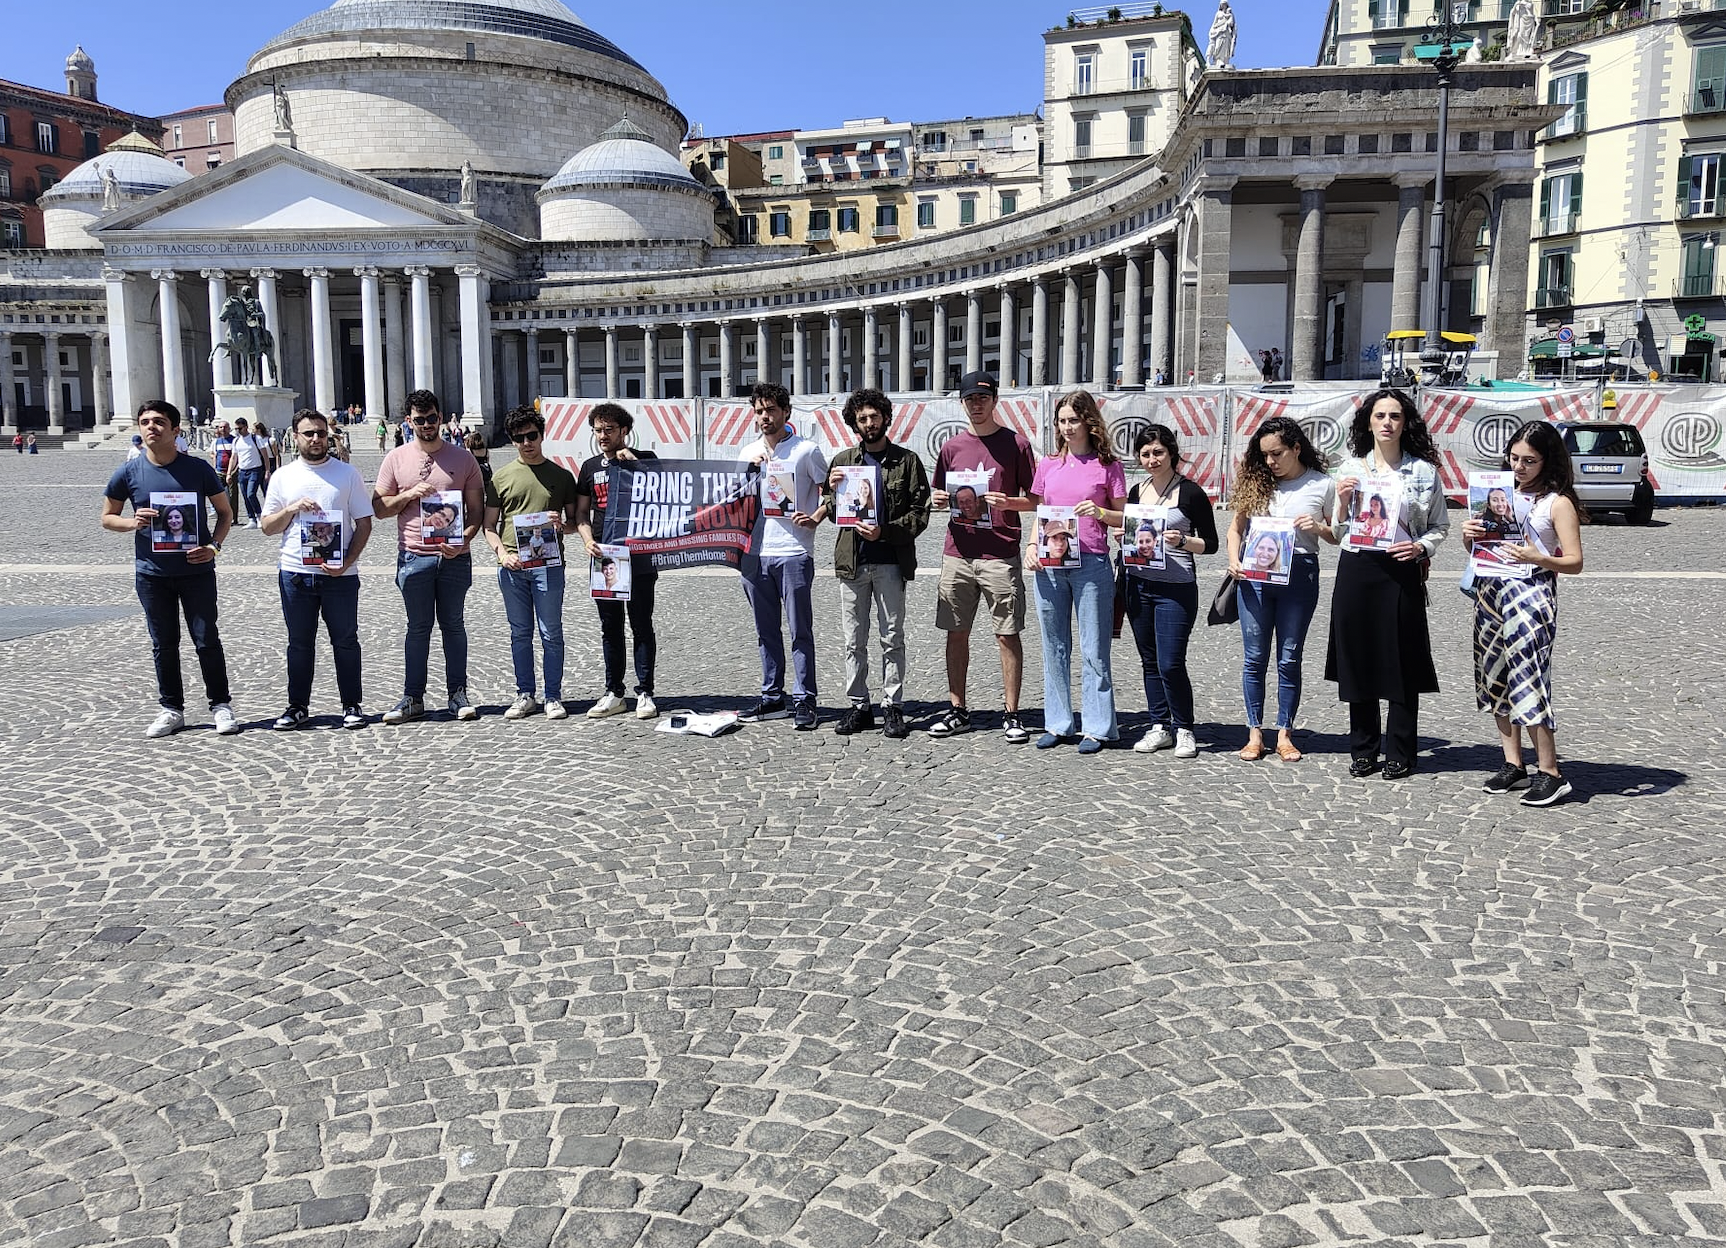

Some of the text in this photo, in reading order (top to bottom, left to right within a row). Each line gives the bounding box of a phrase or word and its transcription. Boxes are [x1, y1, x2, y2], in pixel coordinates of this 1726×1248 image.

[157, 244, 216, 254] FRANCISCO
[219, 244, 233, 253] DE
[274, 242, 345, 252] FERDINANDVS
[354, 242, 367, 251] EX
[371, 241, 400, 251] VOTO
[632, 471, 693, 504] BRING
[700, 472, 757, 504] THEM
[627, 496, 755, 538] HOME NOW!
[664, 540, 678, 548] AND
[679, 535, 708, 546] MISSING
[709, 532, 737, 543] FAMILIES
